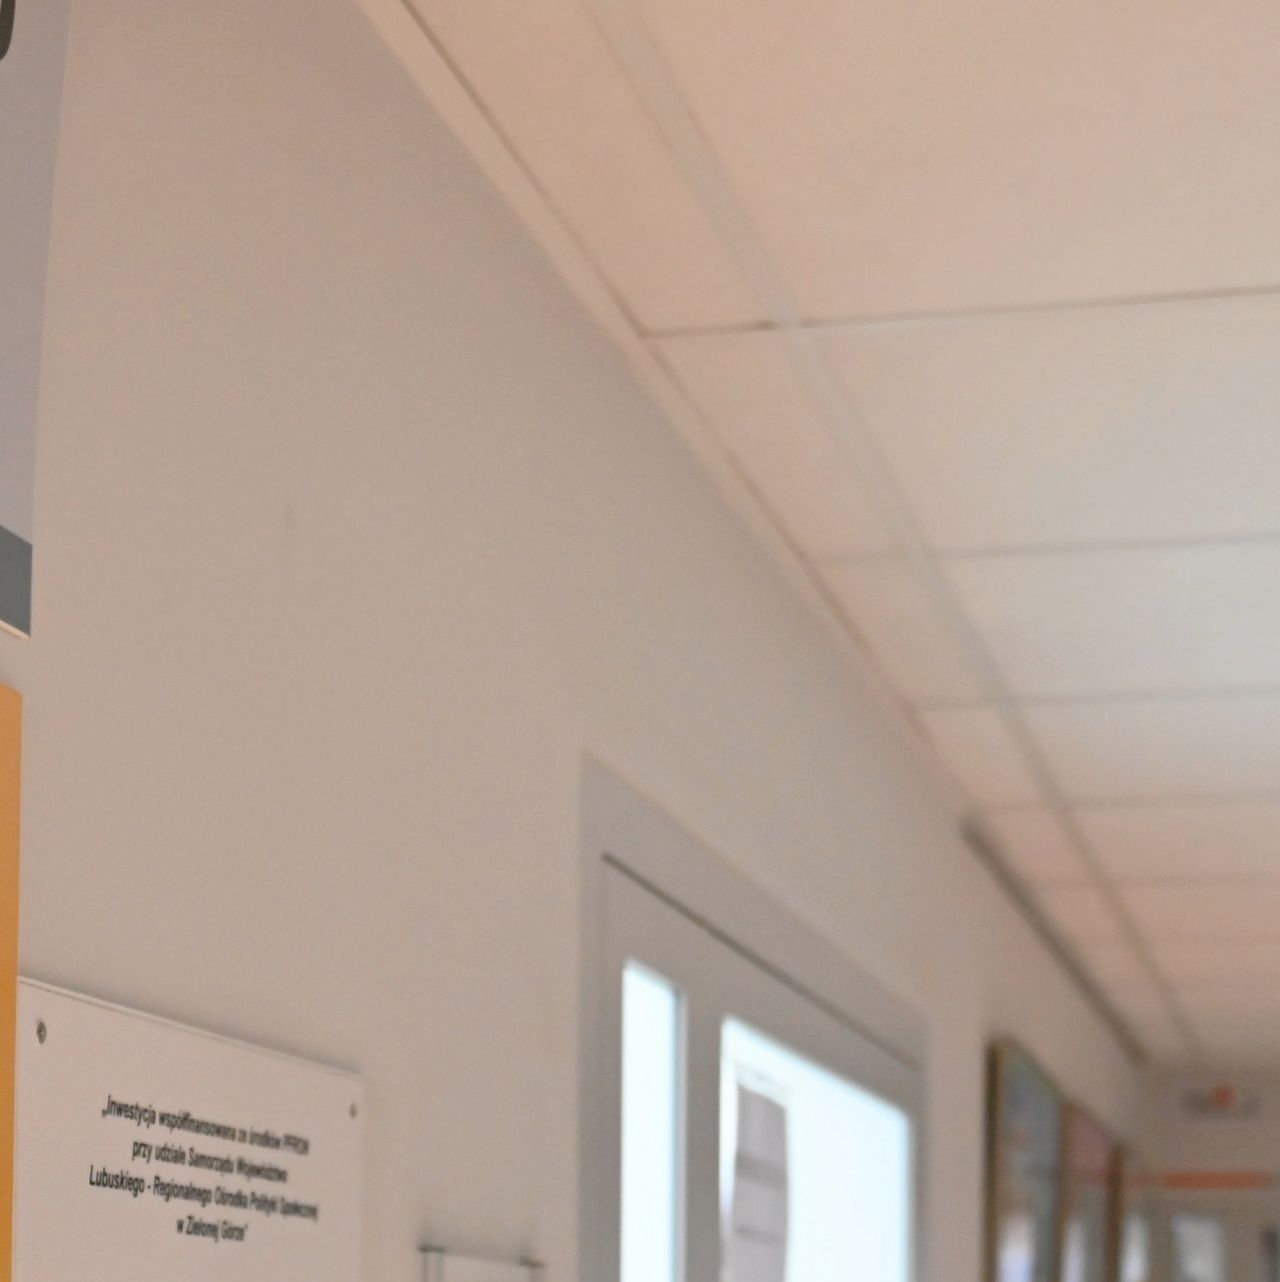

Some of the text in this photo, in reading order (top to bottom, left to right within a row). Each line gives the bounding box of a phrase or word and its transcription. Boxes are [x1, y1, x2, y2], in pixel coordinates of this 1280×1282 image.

[133, 1141, 152, 1163] przy
[89, 1165, 145, 1198] Lubuskiego
[153, 1175, 212, 1207] Regionalnego
[176, 1219, 184, 1233] w
